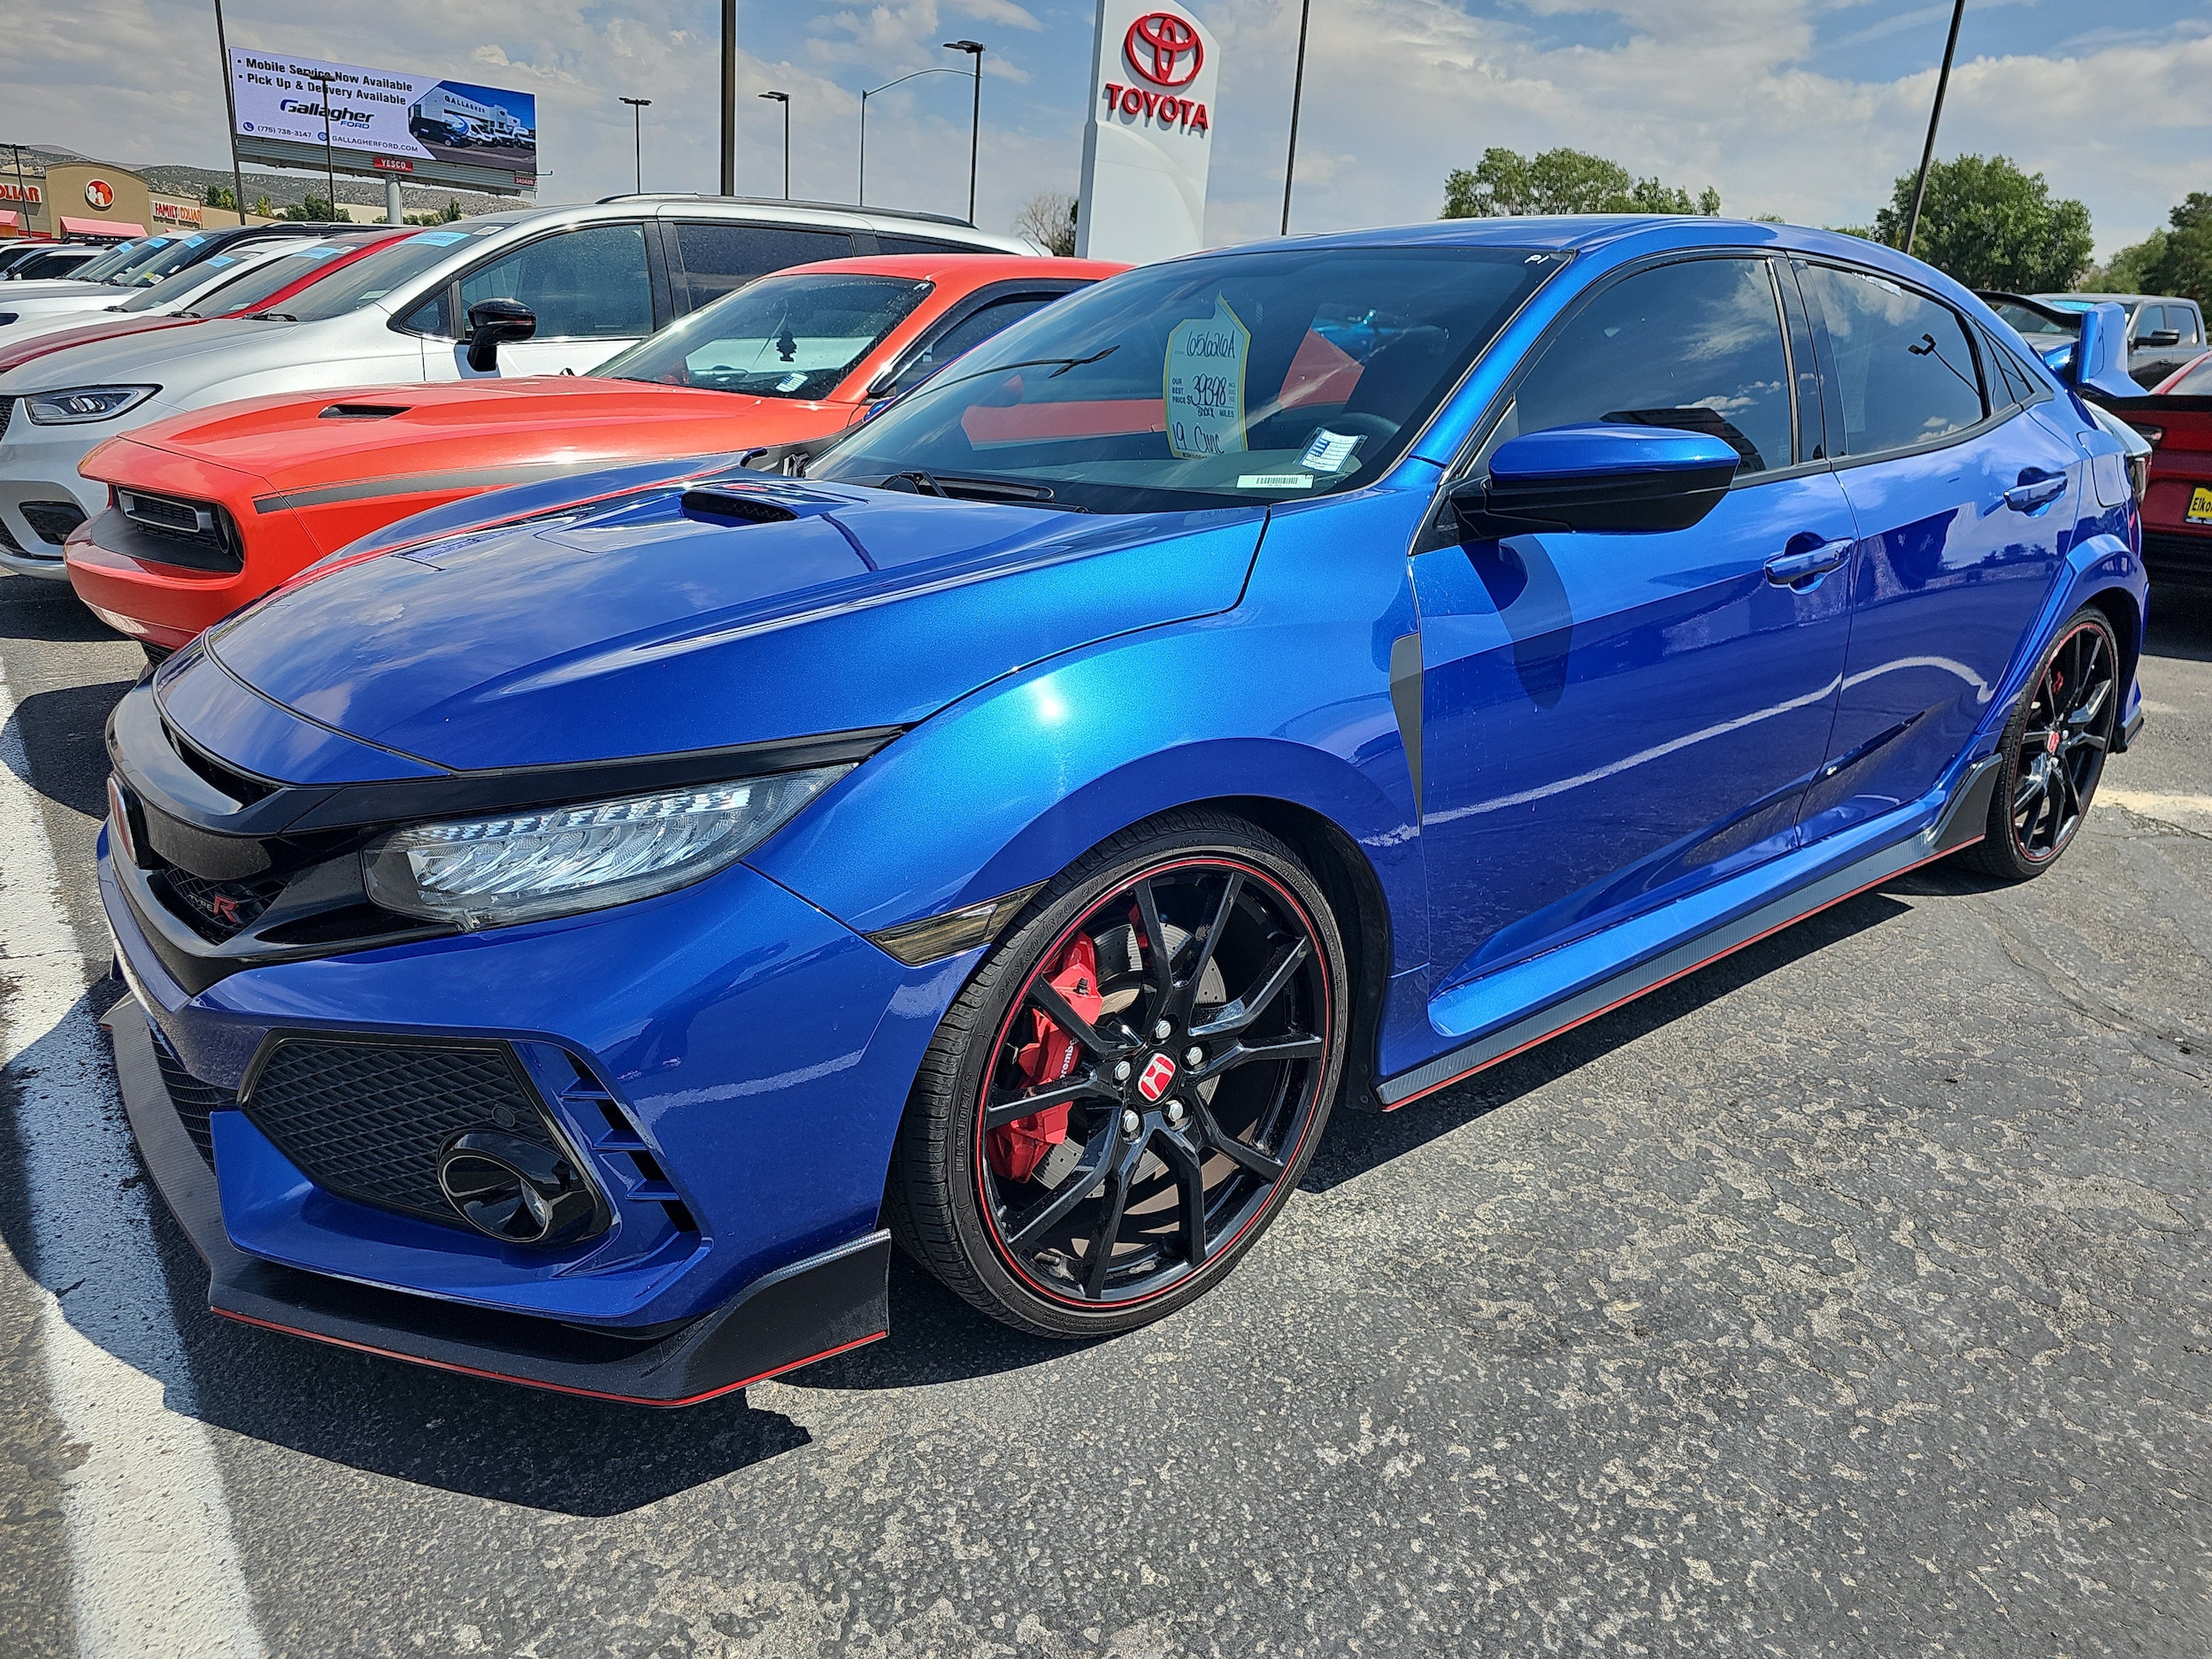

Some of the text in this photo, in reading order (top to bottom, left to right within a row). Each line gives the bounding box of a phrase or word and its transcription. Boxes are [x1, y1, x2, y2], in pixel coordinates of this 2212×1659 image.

[246, 58, 412, 92] Mobile Service Now Available
[247, 73, 406, 105] Pick Up & Deivery Available
[280, 98, 374, 123] Gallagher
[1105, 82, 1209, 130] TOYOTA
[257, 125, 311, 138] (775) 738-3147
[340, 120, 370, 129] FORD
[332, 134, 419, 152] GALLAGHERFORD.COM
[155, 203, 202, 222] FAMILY DOLLAR
[1172, 396, 1186, 404] PRICE
[1219, 410, 1235, 419] MILES
[2193, 496, 2212, 512] Elko
[187, 894, 238, 923] TYPE R
